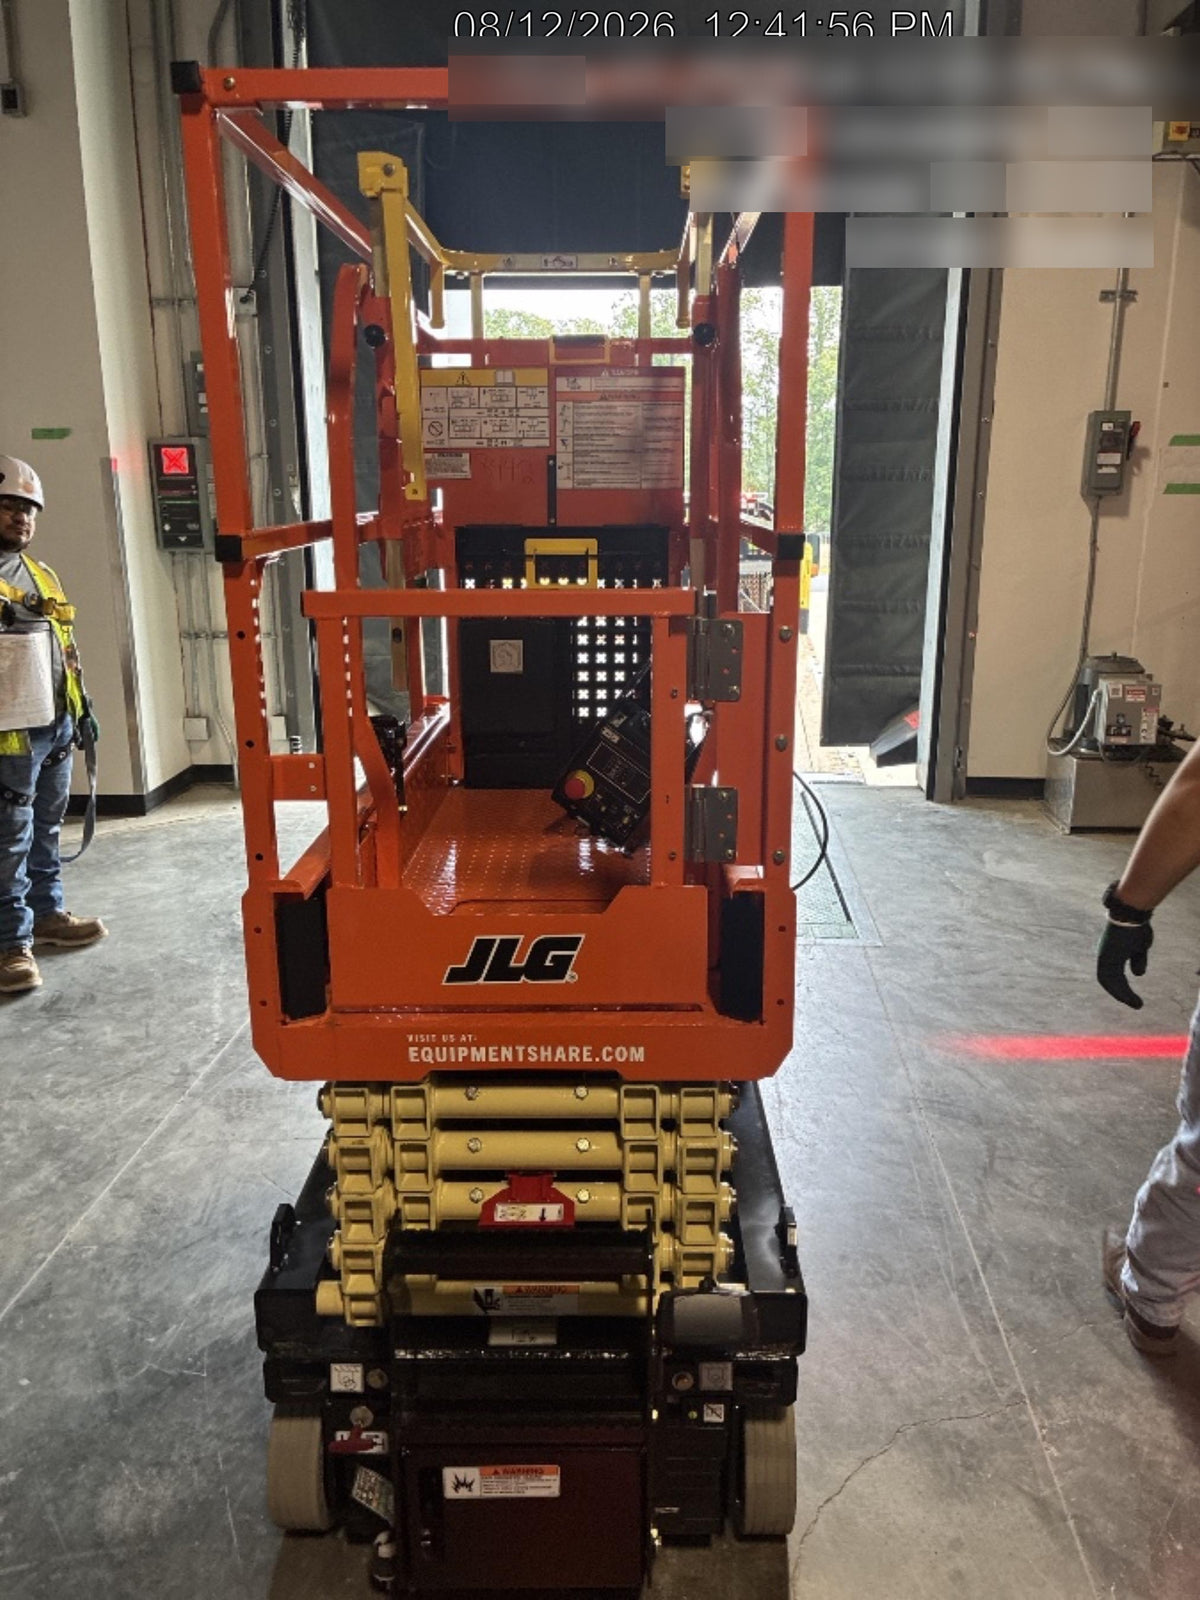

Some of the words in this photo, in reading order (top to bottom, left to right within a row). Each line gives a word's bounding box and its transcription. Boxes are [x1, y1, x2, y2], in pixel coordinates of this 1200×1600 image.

[442, 934, 586, 986] JLG
[406, 1034, 437, 1043] VISIT
[442, 1034, 456, 1043] US
[408, 1046, 646, 1064] EQUIPMENTSHARE.COM
